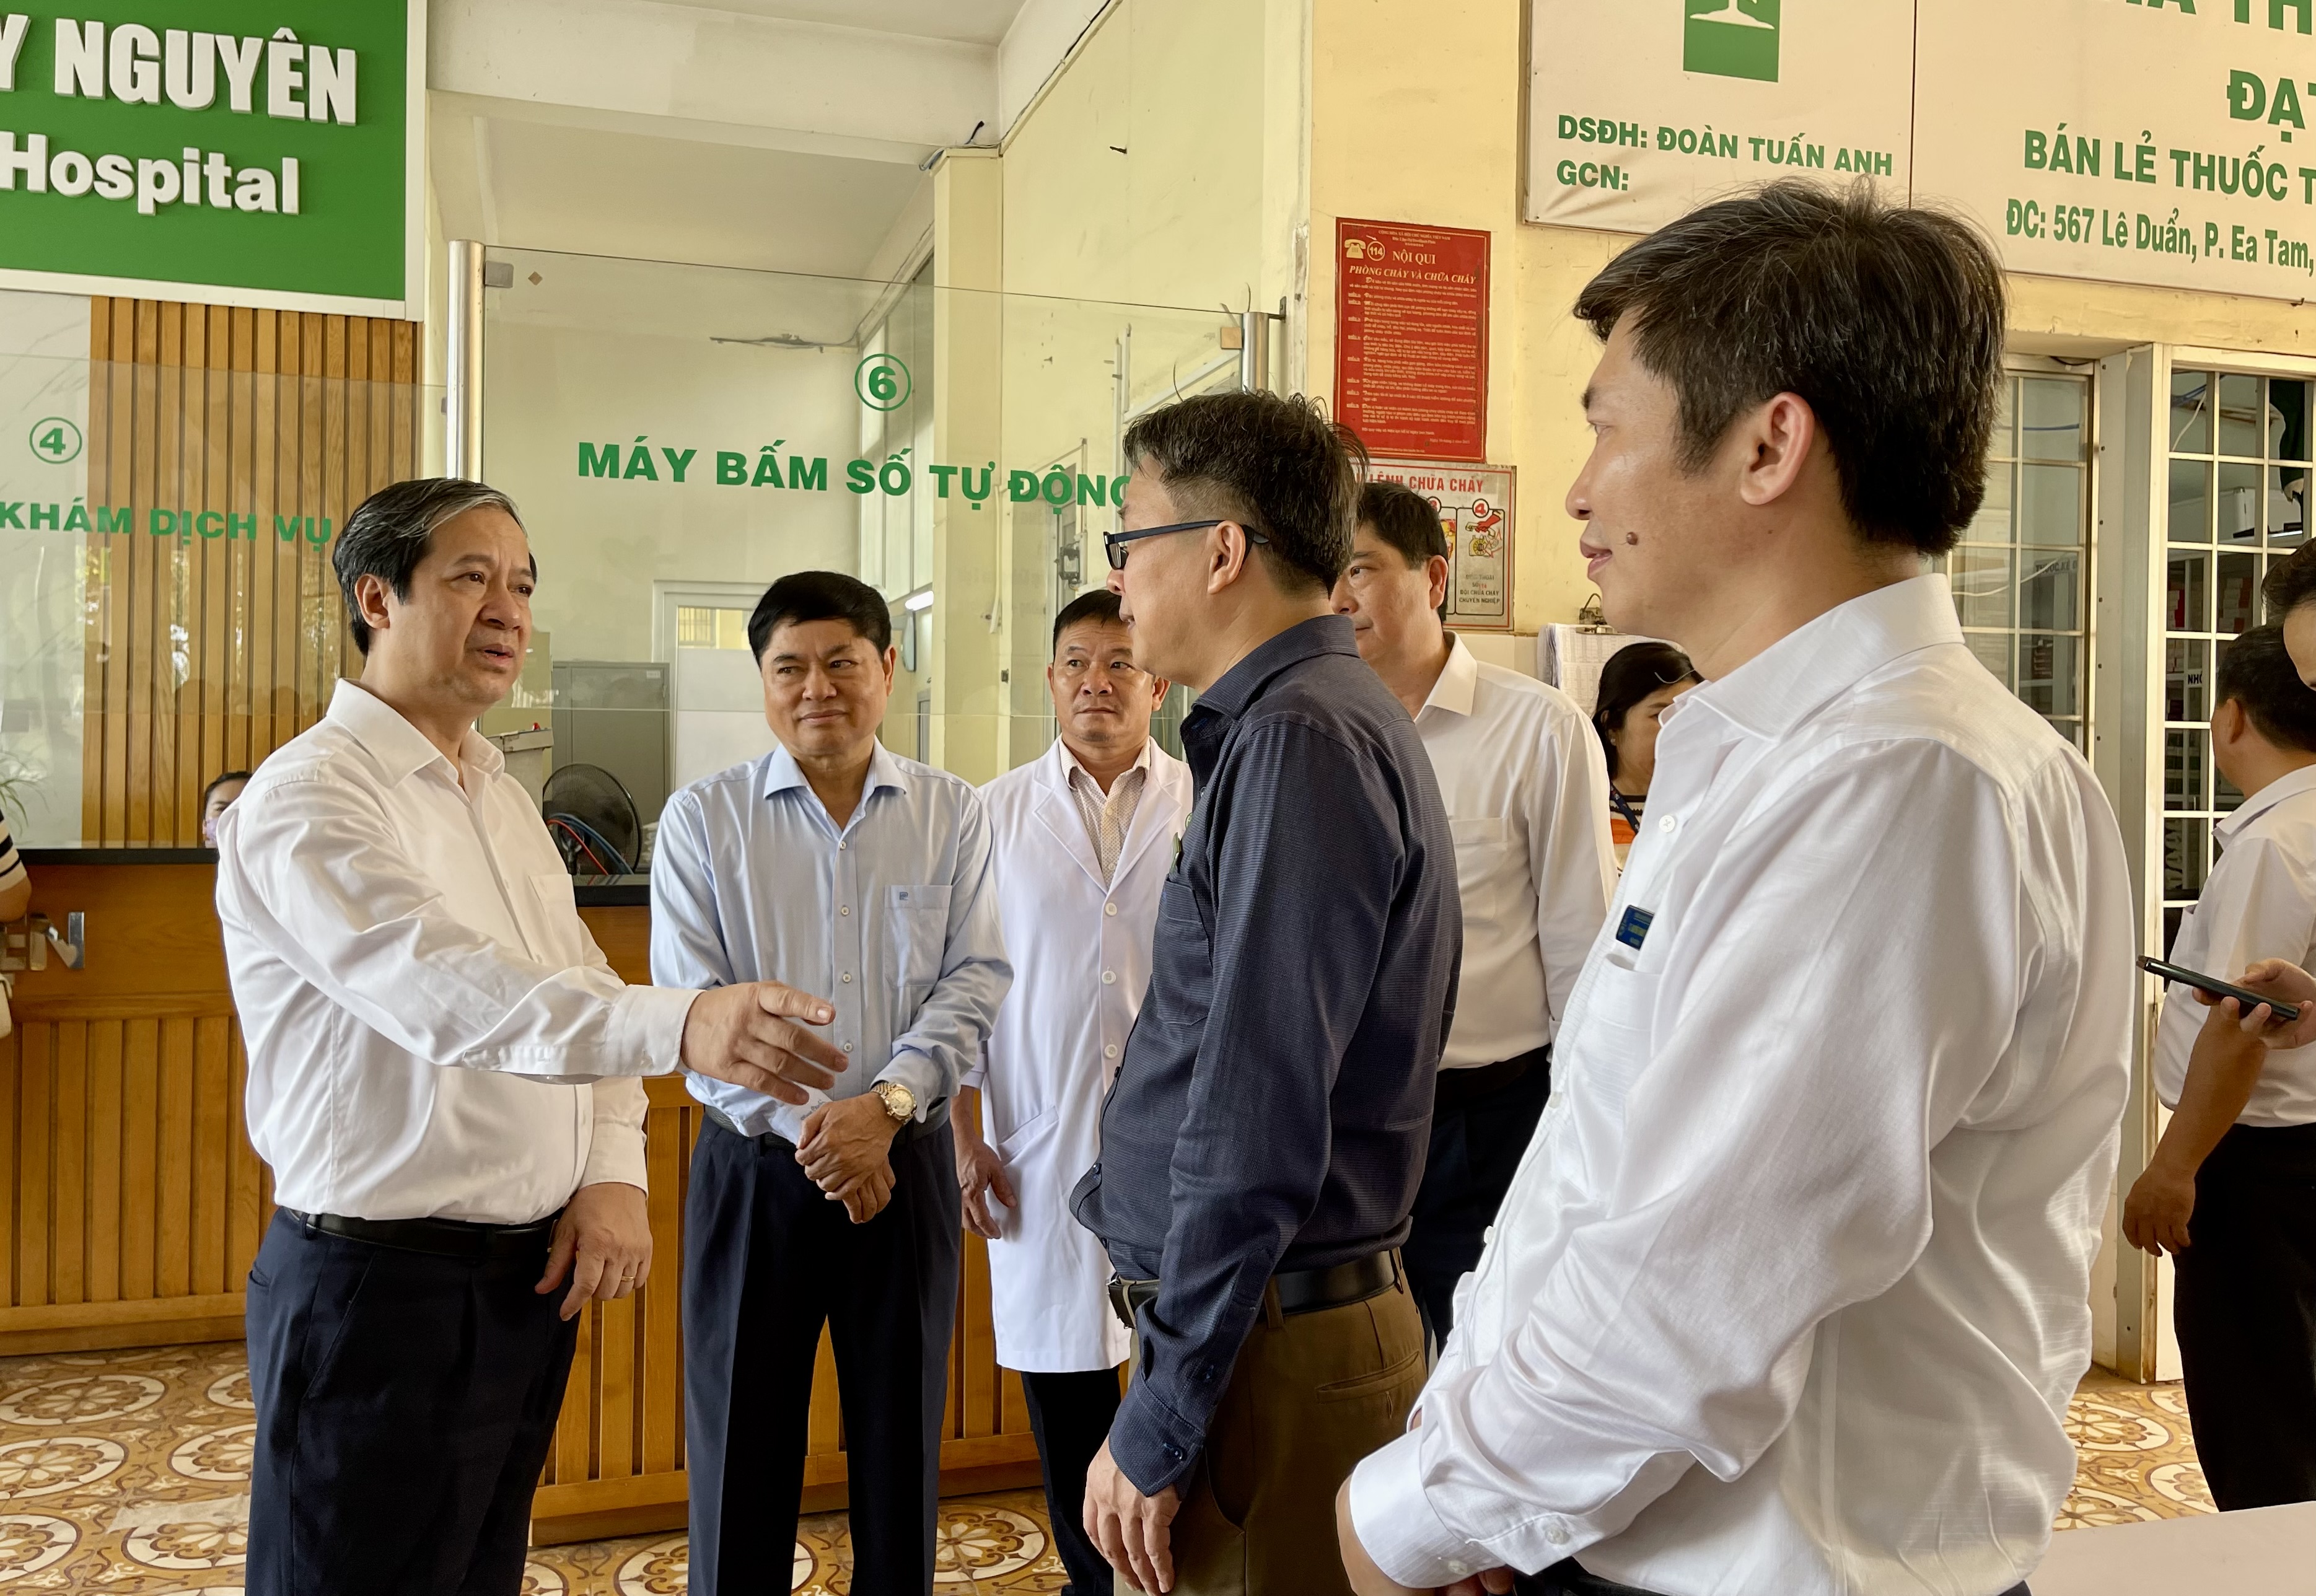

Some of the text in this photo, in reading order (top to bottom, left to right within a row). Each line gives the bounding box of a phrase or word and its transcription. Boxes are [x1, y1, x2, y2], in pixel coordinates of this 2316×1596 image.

[55, 27, 356, 126] NGUYÊN
[2227, 69, 2316, 143] ĐẠ
[1558, 115, 1892, 177] DSĐH: ĐOÀN TUẤN ANH
[2024, 123, 2100, 177] BÁN
[2114, 130, 2157, 184] LẺ
[2169, 145, 2288, 201] THUỐC
[0, 131, 299, 215] Hospital
[1556, 160, 1628, 191] GCN:
[1369, 247, 1384, 256] 114
[1393, 249, 1436, 265] NỘI QUI
[2006, 198, 2314, 274] ĐC: 567 Lê Duẩn, P. Ea Tam,
[1349, 265, 1477, 285] PHÒNG CHÁY VÀ CHỮA CHÁY
[869, 366, 897, 401] 6
[39, 428, 66, 455] 4
[578, 436, 697, 483] MÁY
[716, 439, 828, 492] BẤM
[845, 447, 912, 496] SỐ
[928, 460, 996, 511] TỰ
[1409, 474, 1445, 491] CHỮA
[1450, 476, 1484, 493] CHÁY
[0, 497, 331, 552] KHÁM DỊCH VỤ
[1475, 502, 1487, 515] 4
